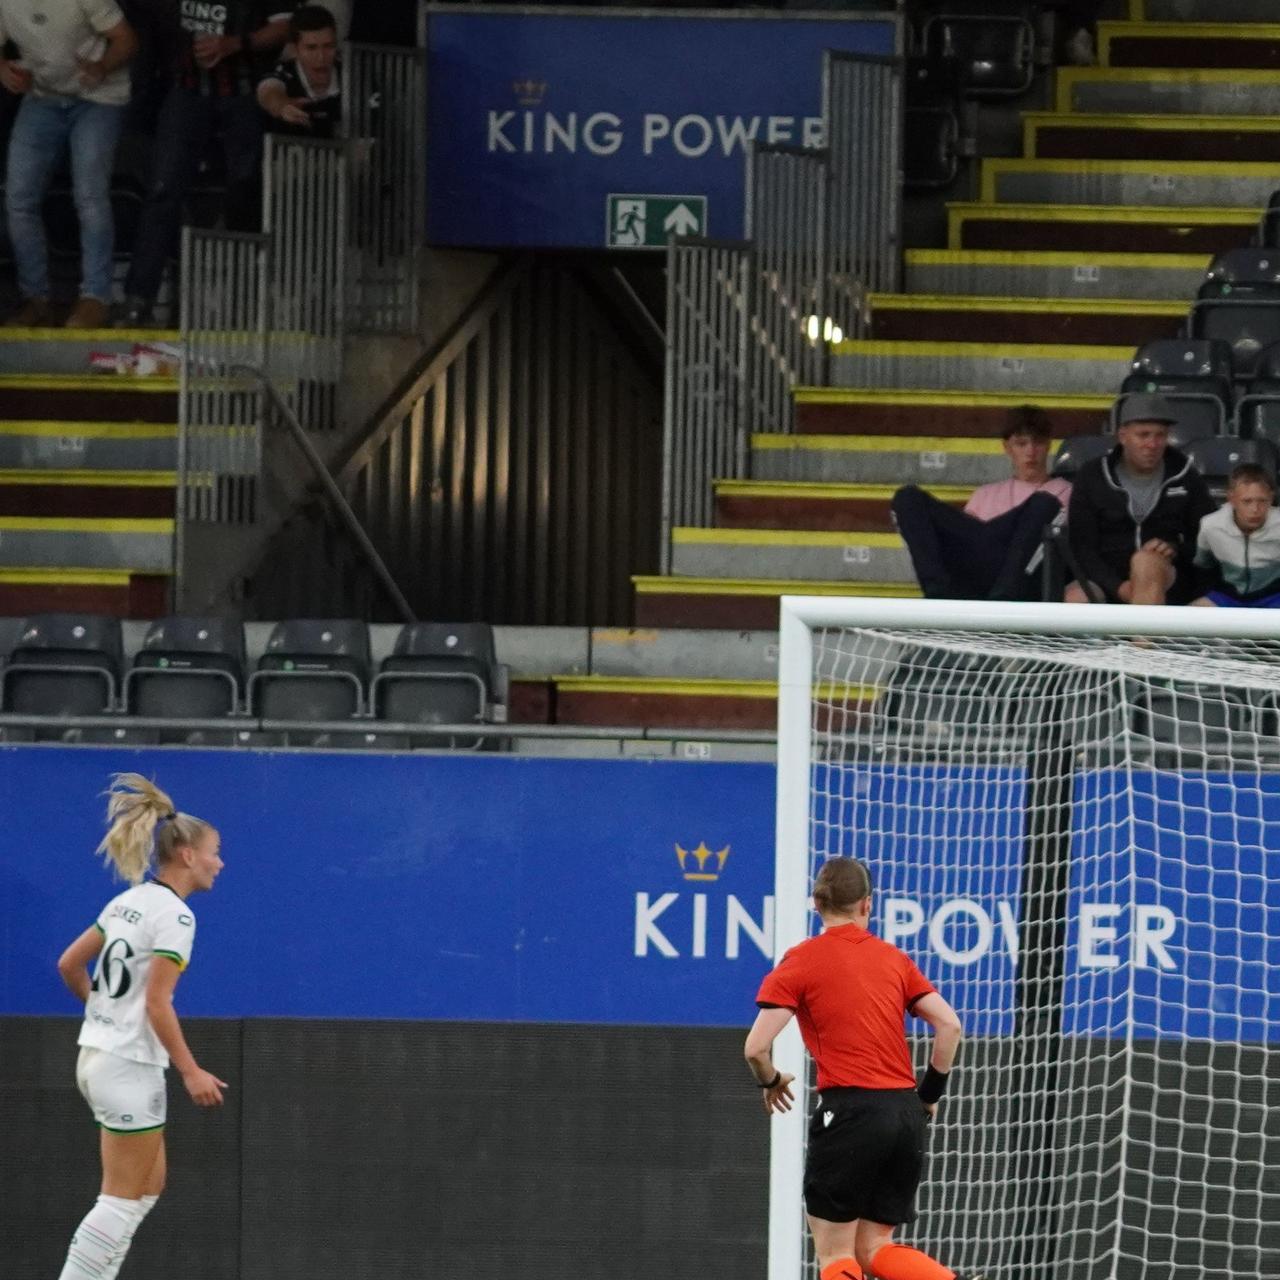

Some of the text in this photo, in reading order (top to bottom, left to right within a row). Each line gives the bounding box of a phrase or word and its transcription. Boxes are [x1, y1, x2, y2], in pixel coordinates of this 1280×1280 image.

[488, 110, 829, 157] KING POWER
[635, 892, 776, 959] KIN
